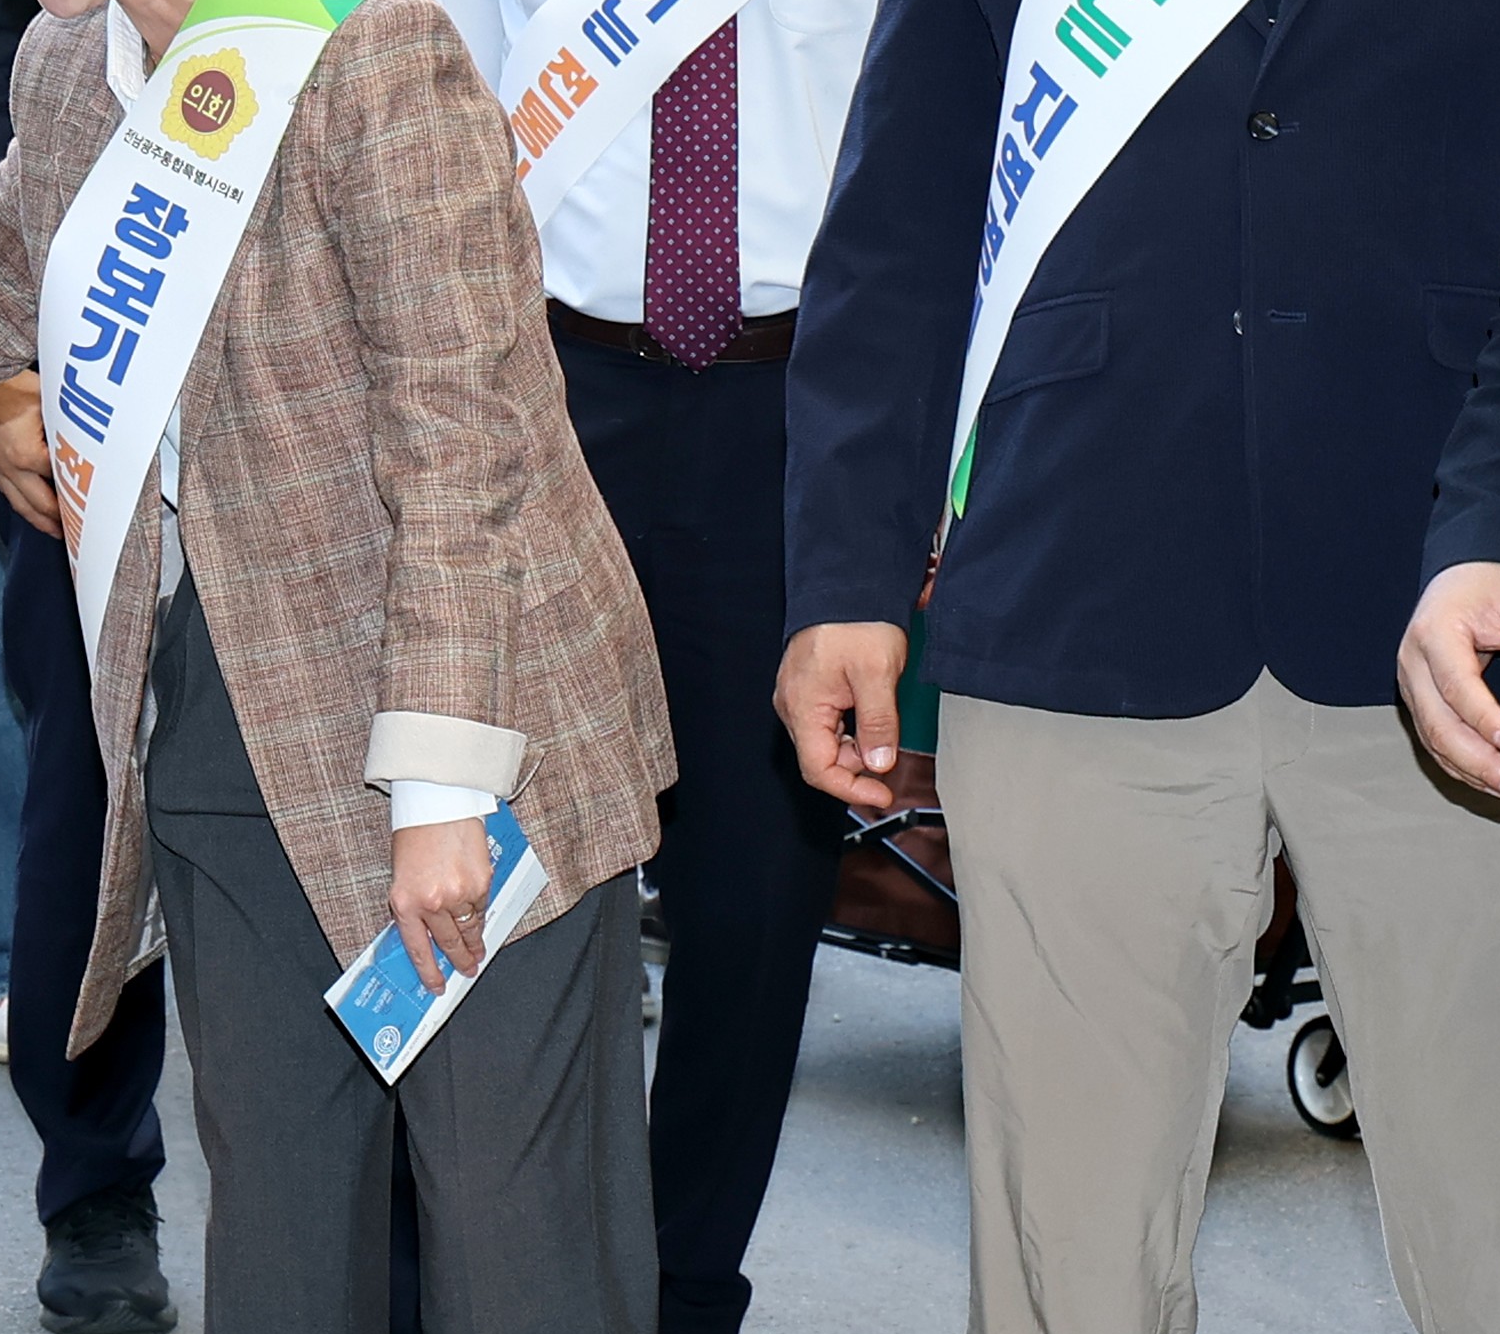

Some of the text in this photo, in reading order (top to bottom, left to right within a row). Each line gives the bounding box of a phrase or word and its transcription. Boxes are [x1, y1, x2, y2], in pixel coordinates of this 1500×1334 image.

[182, 82, 233, 127] 의회
[122, 126, 246, 206] 전남광주통합특별시의회
[56, 182, 192, 445] 장보기는
